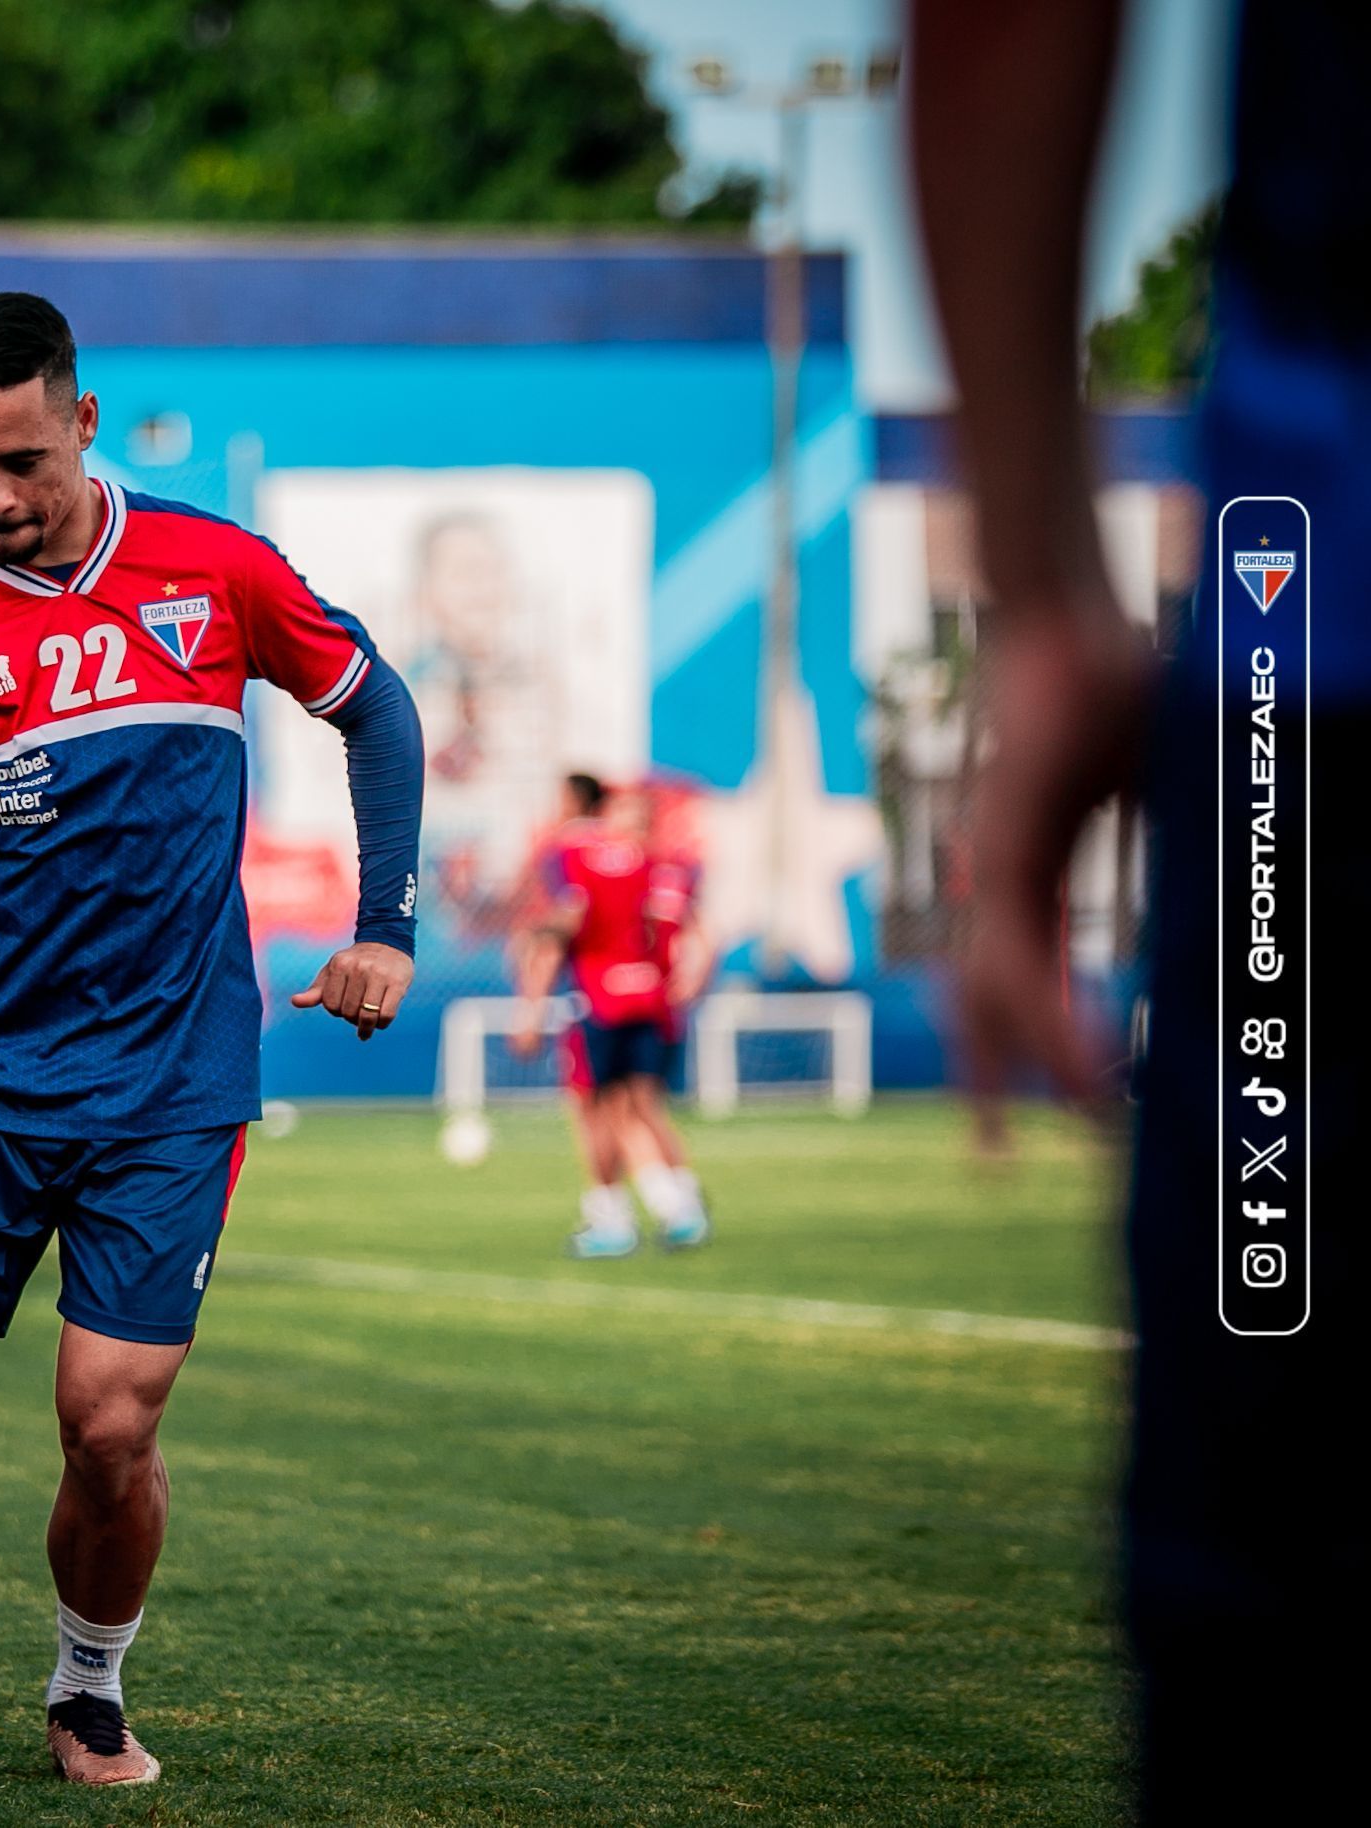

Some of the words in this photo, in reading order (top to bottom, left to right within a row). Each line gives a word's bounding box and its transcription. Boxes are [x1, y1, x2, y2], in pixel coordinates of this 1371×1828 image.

[143, 601, 207, 620] FORTALEZA
[38, 623, 137, 713] 22
[0, 807, 59, 826] brisanet
[398, 873, 417, 917] VOLT
